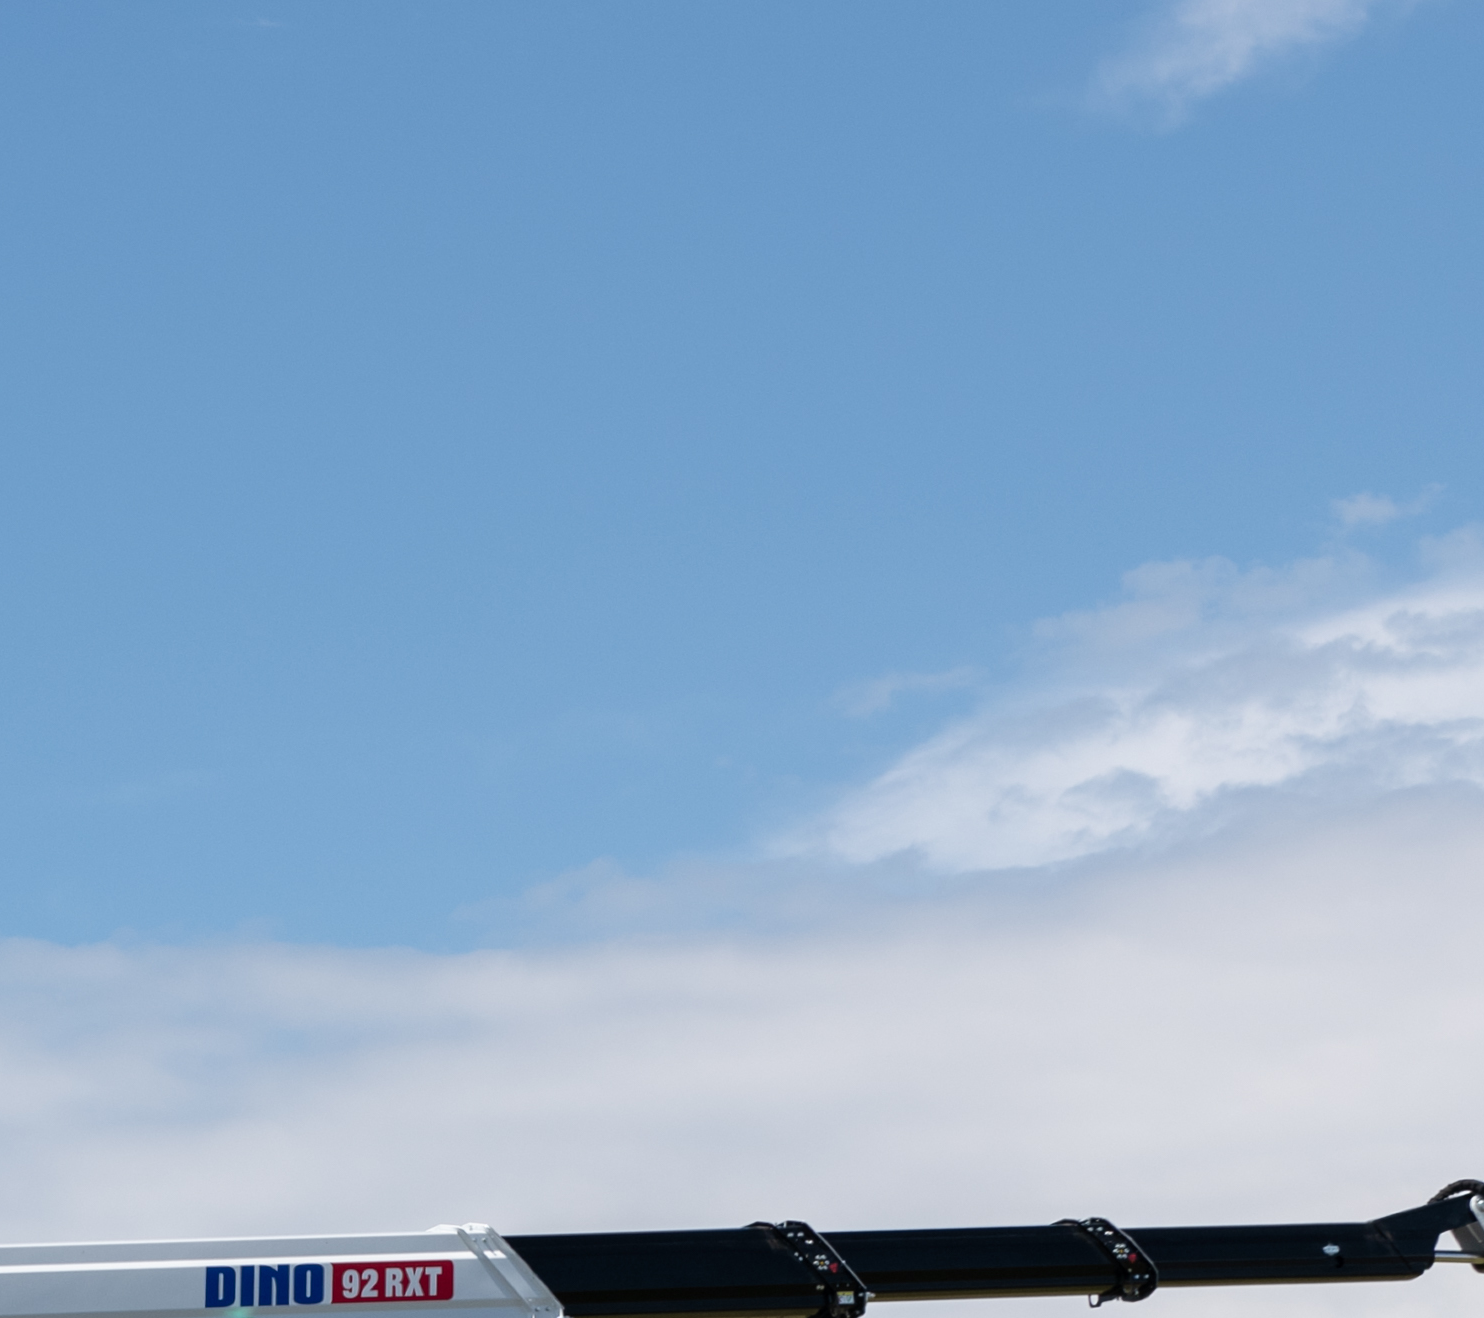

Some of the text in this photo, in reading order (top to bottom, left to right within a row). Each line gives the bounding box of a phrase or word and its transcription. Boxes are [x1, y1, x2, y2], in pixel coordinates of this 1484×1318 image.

[205, 1263, 443, 1308] DINO 92 RXT
